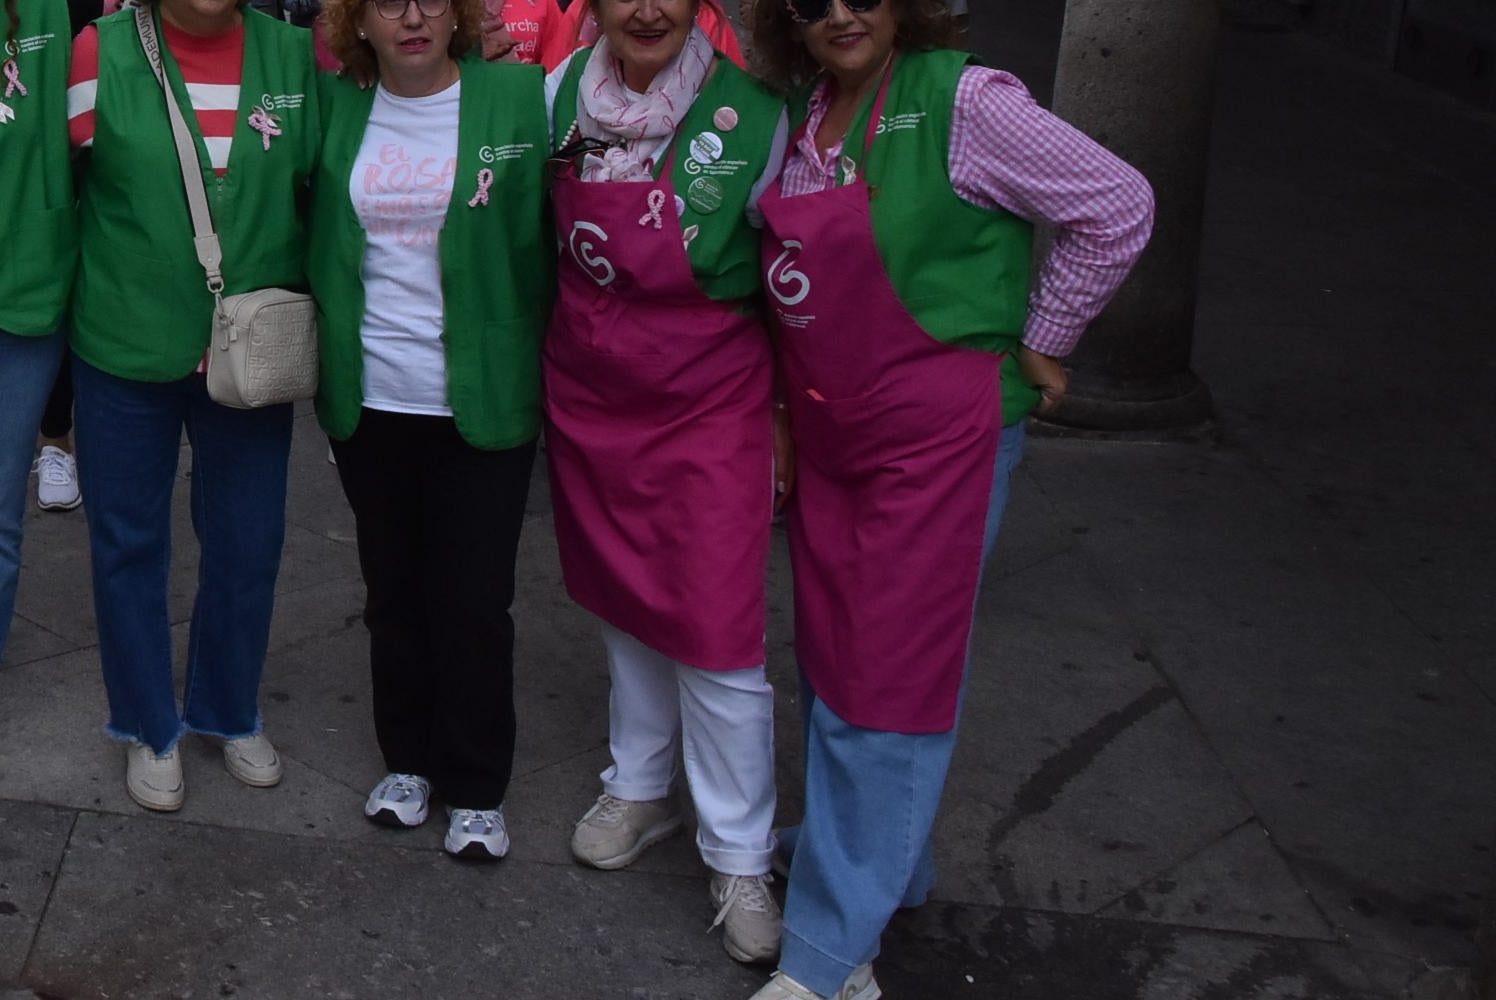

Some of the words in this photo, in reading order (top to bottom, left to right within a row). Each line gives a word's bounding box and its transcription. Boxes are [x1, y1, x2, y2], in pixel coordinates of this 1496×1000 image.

[504, 18, 540, 33] archa
[379, 143, 411, 165] EL
[363, 157, 457, 195] ROSA
